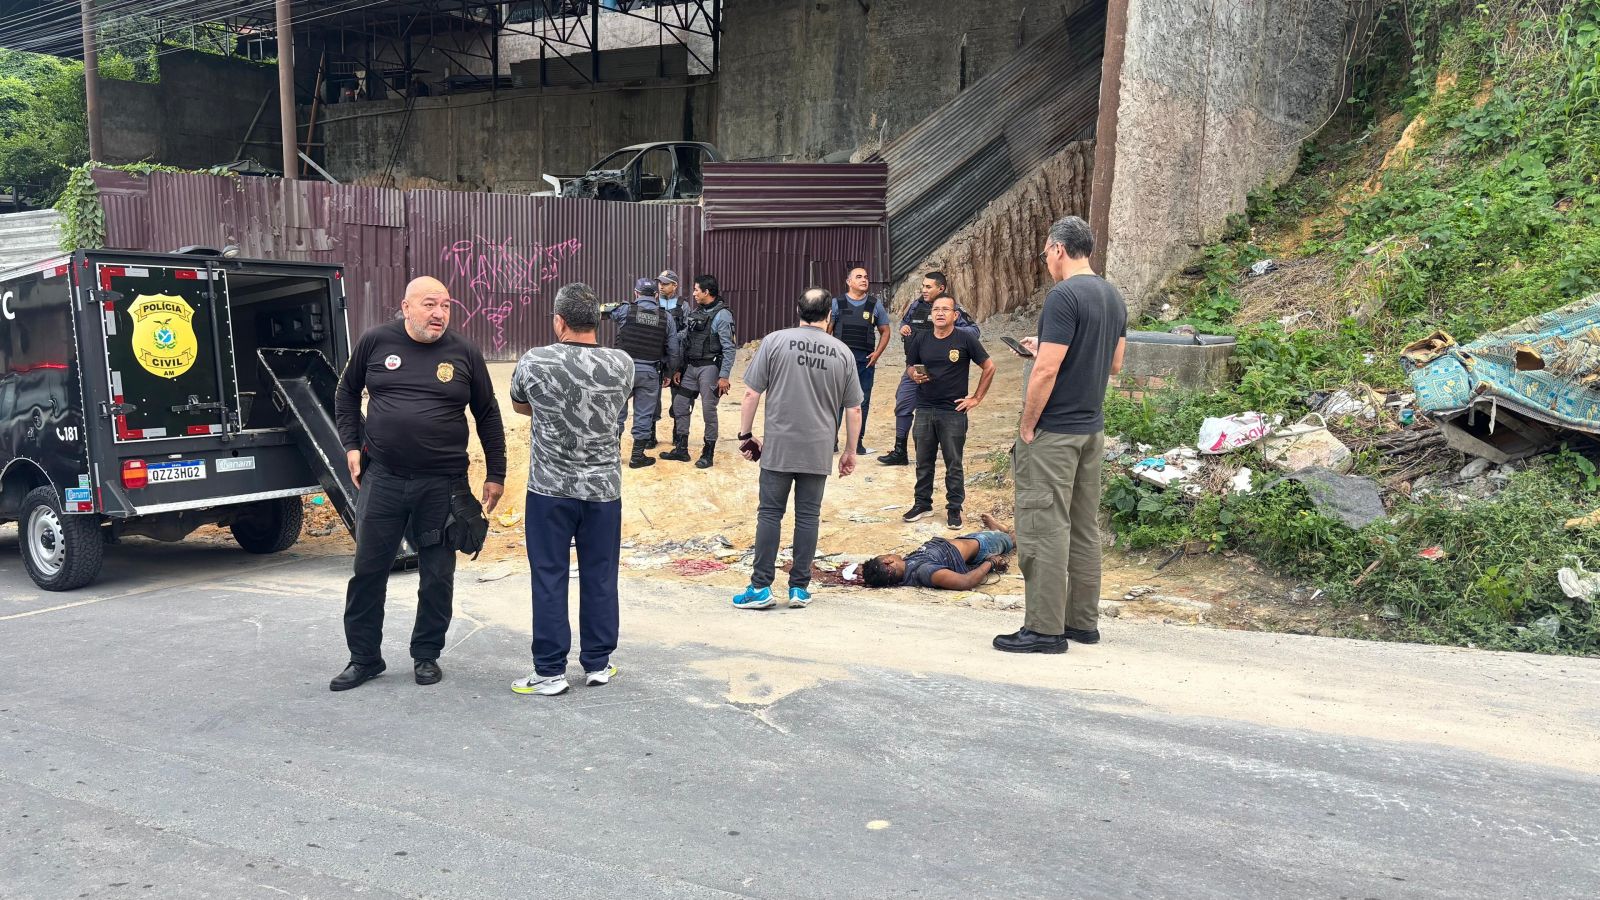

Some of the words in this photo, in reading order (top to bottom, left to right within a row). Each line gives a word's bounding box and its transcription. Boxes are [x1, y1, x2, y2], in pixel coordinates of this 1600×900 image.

[0, 291, 15, 320] C
[143, 302, 182, 313] POLÍCIA
[789, 340, 837, 358] POLÍCIA
[152, 358, 183, 367] CIVIL
[797, 354, 828, 371] CIVIL
[63, 426, 78, 441] 181
